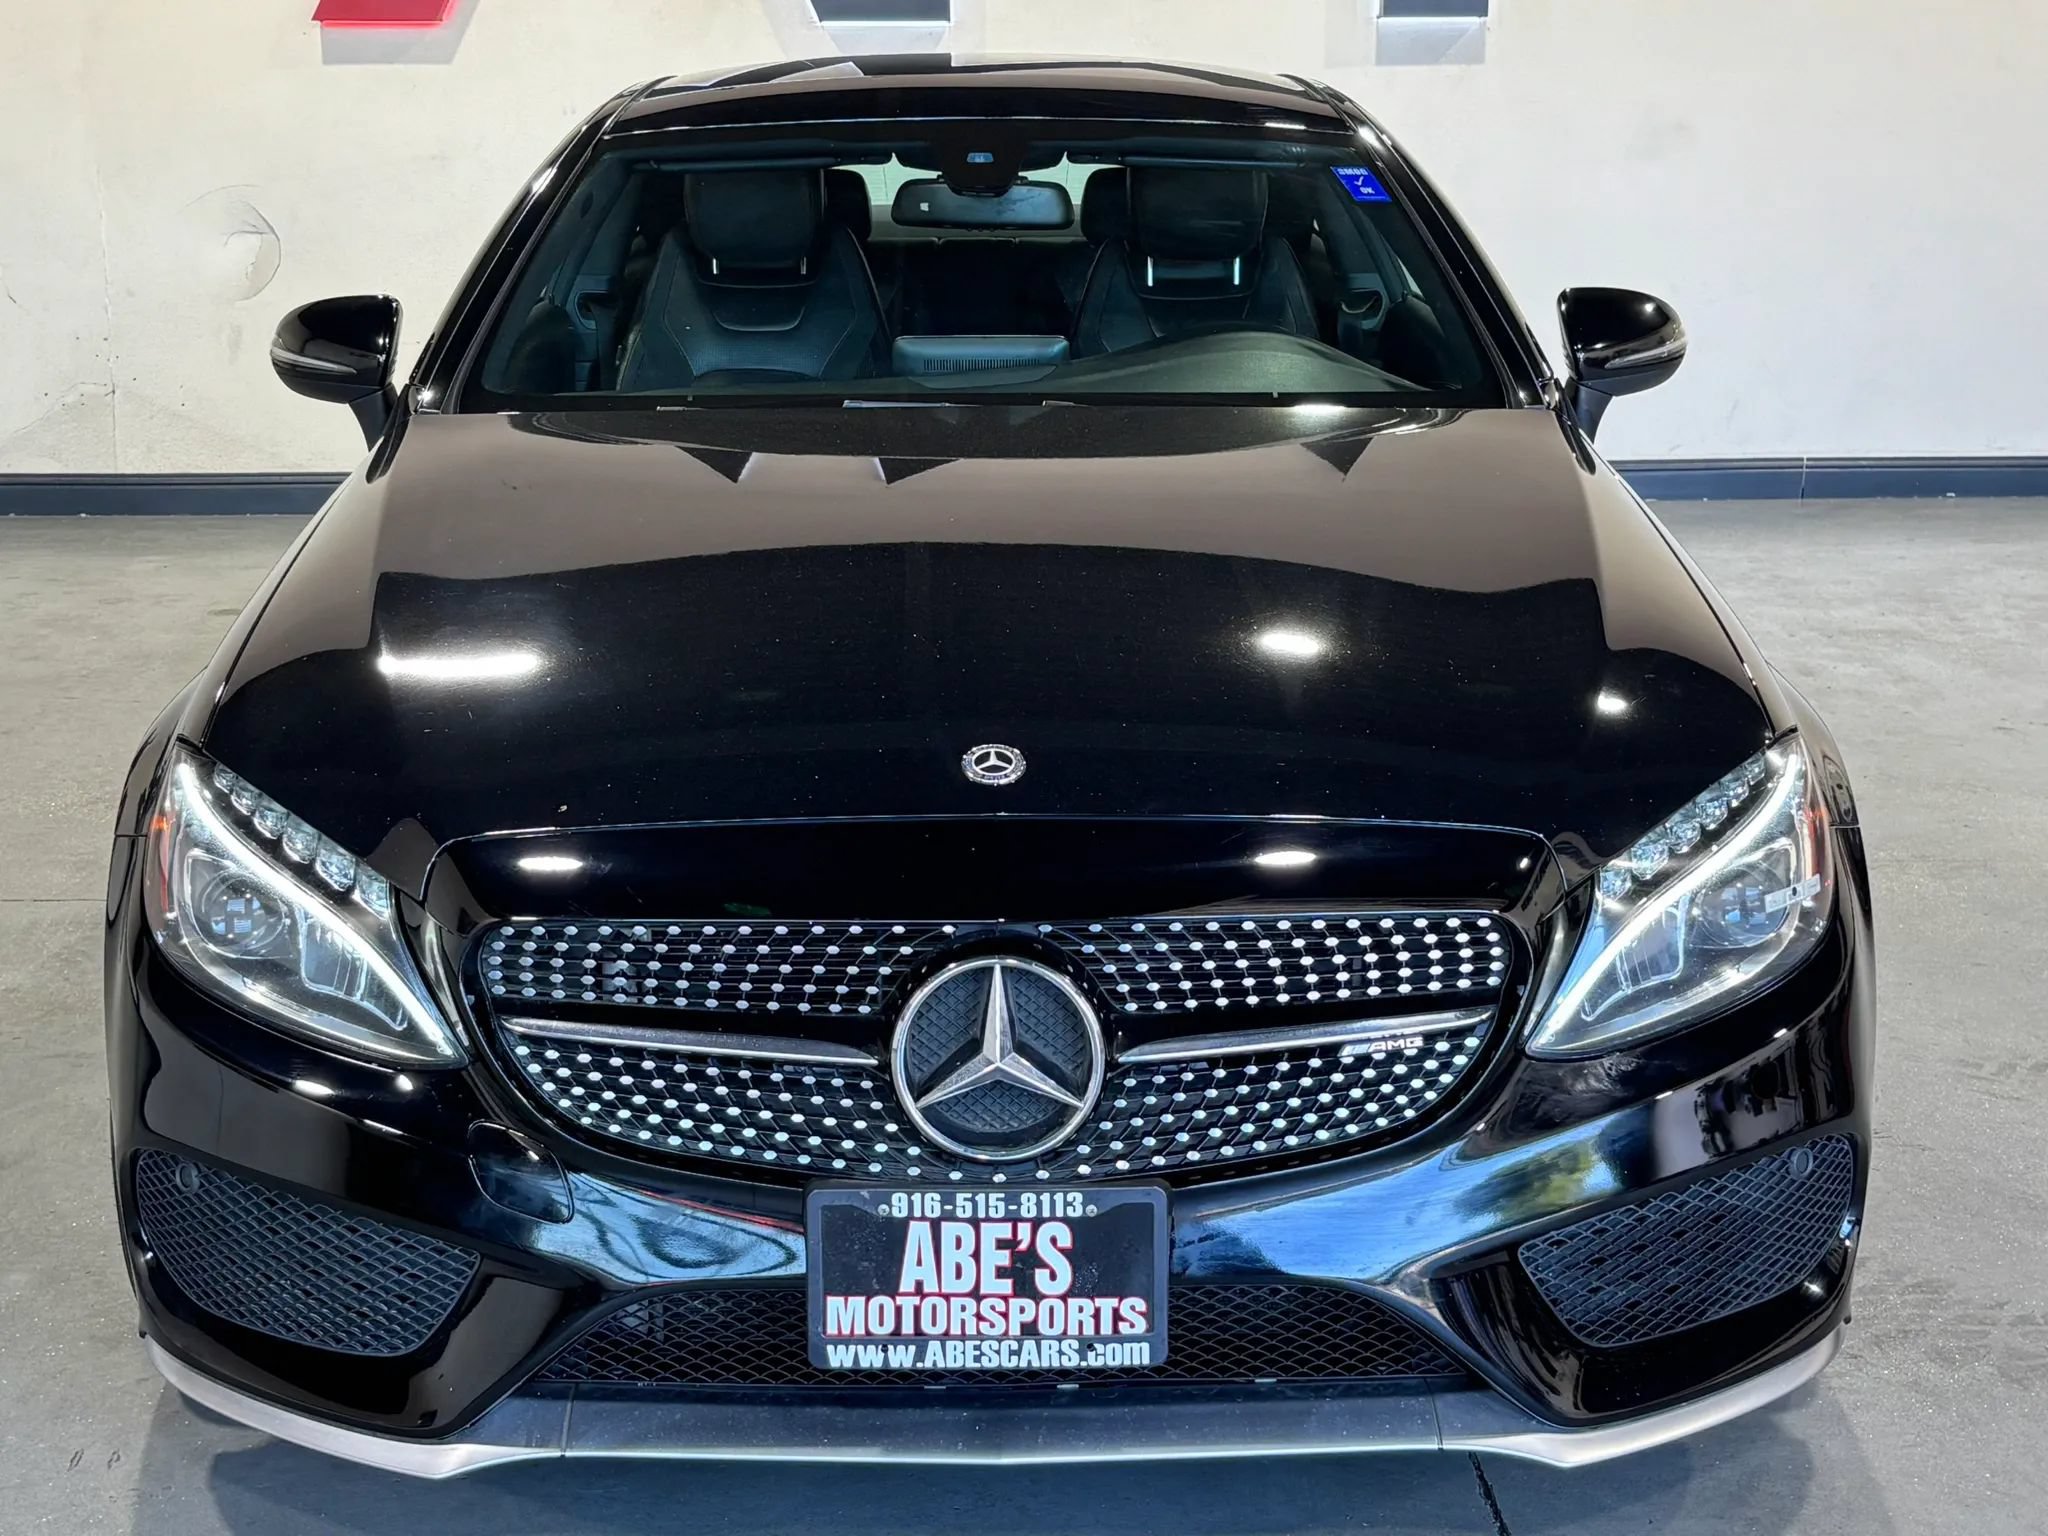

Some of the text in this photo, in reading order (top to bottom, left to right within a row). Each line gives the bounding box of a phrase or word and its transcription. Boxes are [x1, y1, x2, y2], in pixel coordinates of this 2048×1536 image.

[1369, 1036, 1424, 1053] AMG
[891, 1191, 1083, 1218] 916-515-8113
[898, 1220, 1073, 1296] ABE'S
[825, 1296, 1148, 1337] MOTORSPORTS
